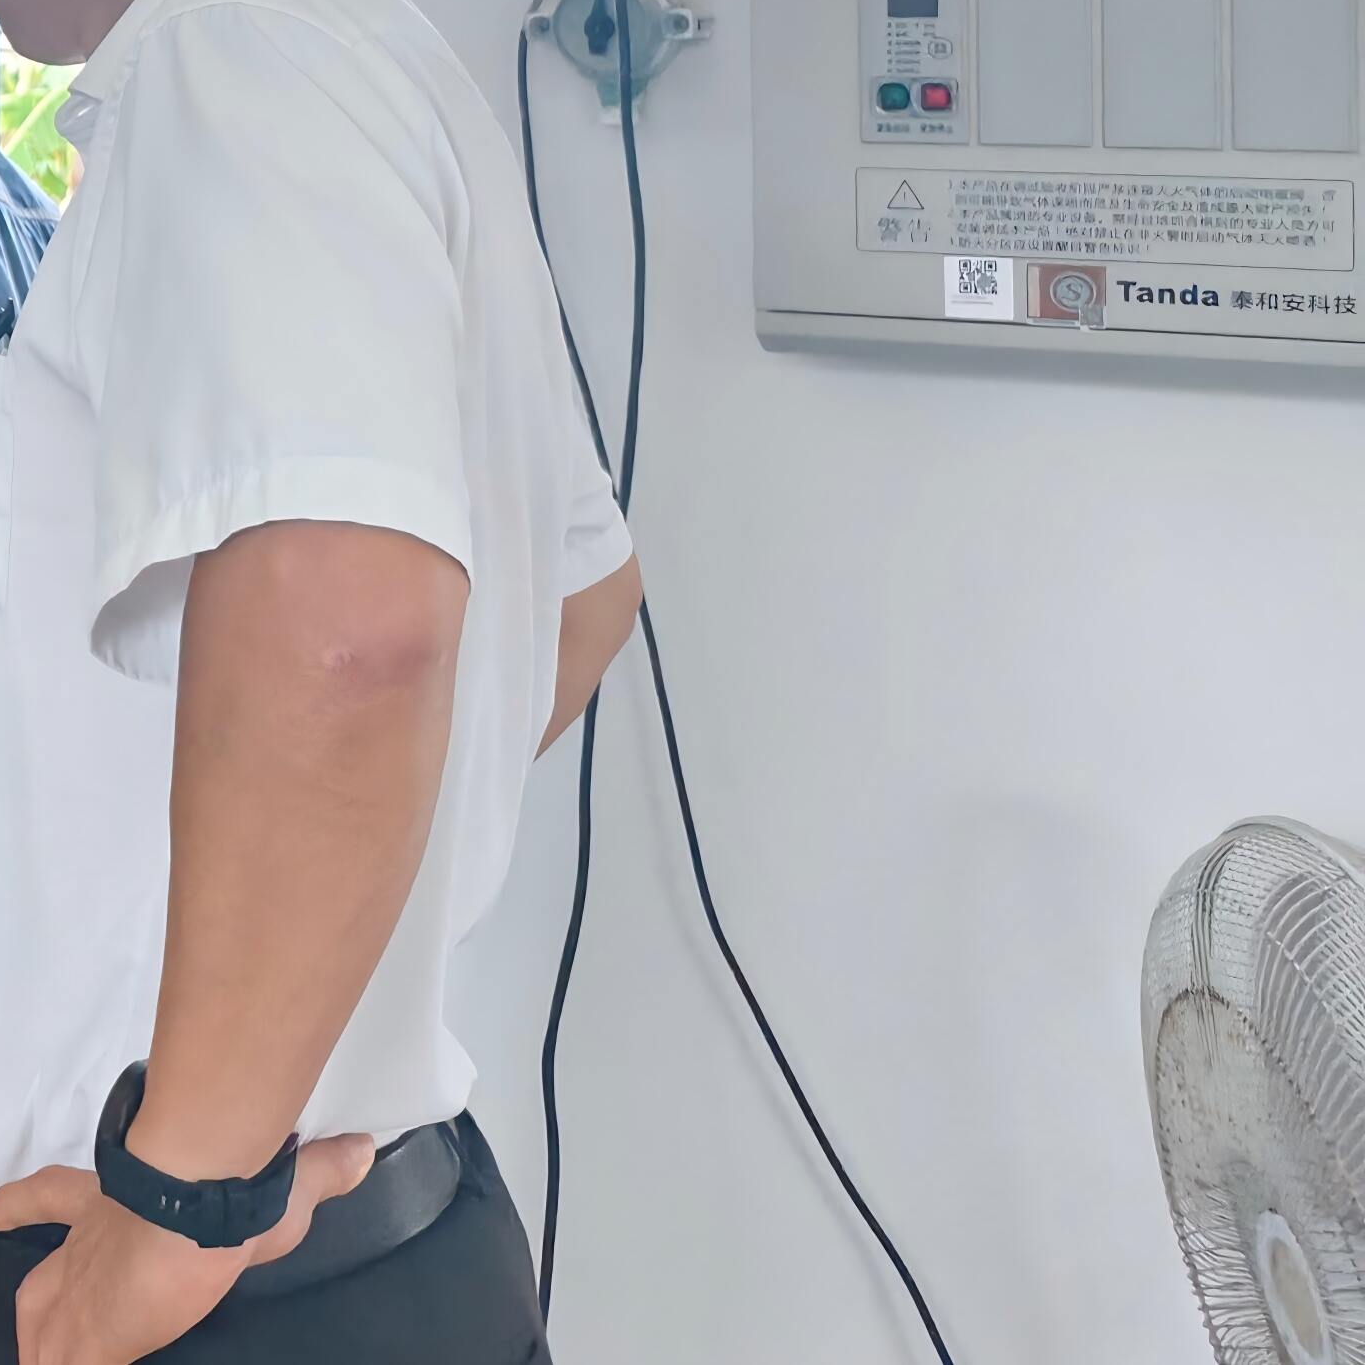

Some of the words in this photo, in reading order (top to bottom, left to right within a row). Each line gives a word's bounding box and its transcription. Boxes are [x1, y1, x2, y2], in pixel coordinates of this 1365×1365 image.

[1116, 280, 1220, 308] Tanda
[1230, 289, 1358, 316] 泰和安科技
